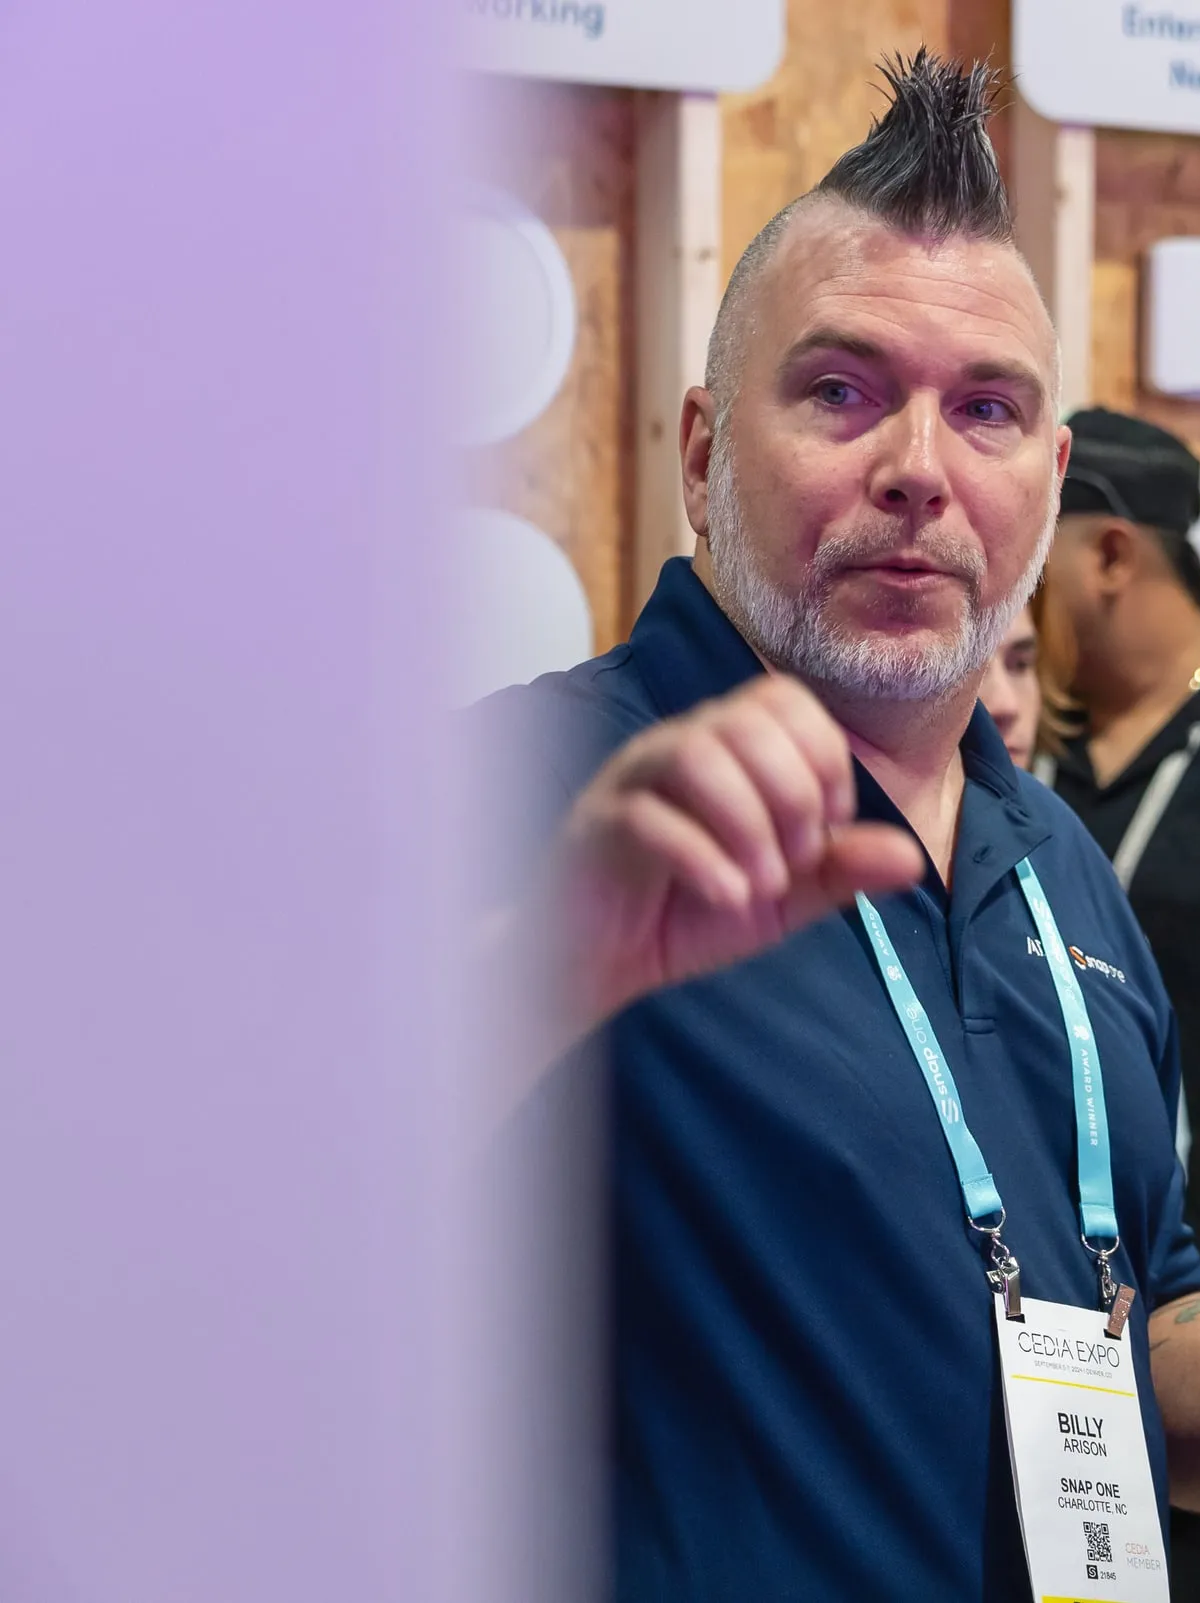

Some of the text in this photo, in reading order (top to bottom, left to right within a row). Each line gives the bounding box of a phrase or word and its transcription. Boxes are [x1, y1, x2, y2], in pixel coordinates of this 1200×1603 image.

[906, 1006, 948, 1096] snap one
[1080, 1047, 1098, 1146] AWARD WINNER
[1018, 1331, 1120, 1368] CEDIA EXPO
[1057, 1412, 1103, 1439] BILLY
[1063, 1438, 1107, 1457] ARISON
[1060, 1477, 1121, 1499] SNAP ONE
[1057, 1496, 1128, 1516] CHARLOTTE, NC
[1125, 1542, 1151, 1556] CEDIA
[1126, 1557, 1161, 1571] MEMBER
